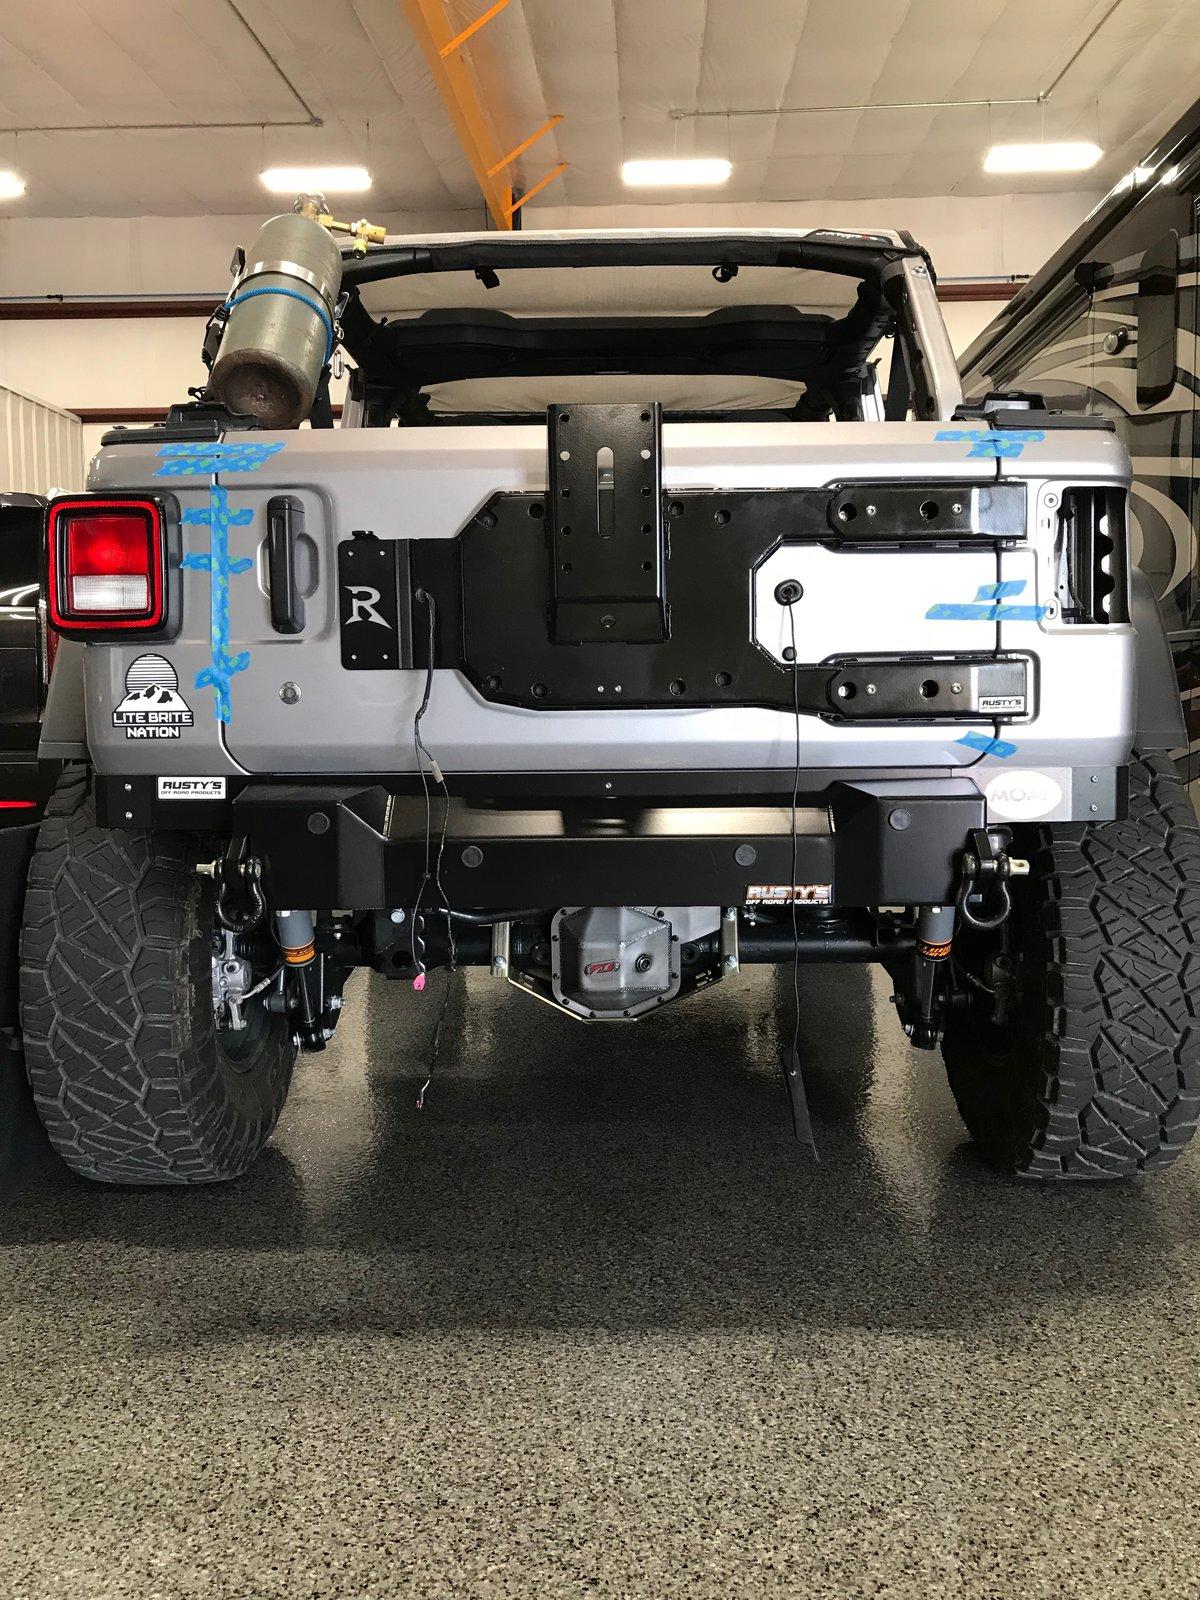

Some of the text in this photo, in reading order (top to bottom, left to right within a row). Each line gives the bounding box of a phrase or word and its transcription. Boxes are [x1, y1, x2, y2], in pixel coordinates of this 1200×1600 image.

[344, 585, 393, 630] R
[113, 712, 192, 723] LITE BRITE
[127, 726, 180, 738] NATION
[162, 781, 222, 790] RUSTY'S
